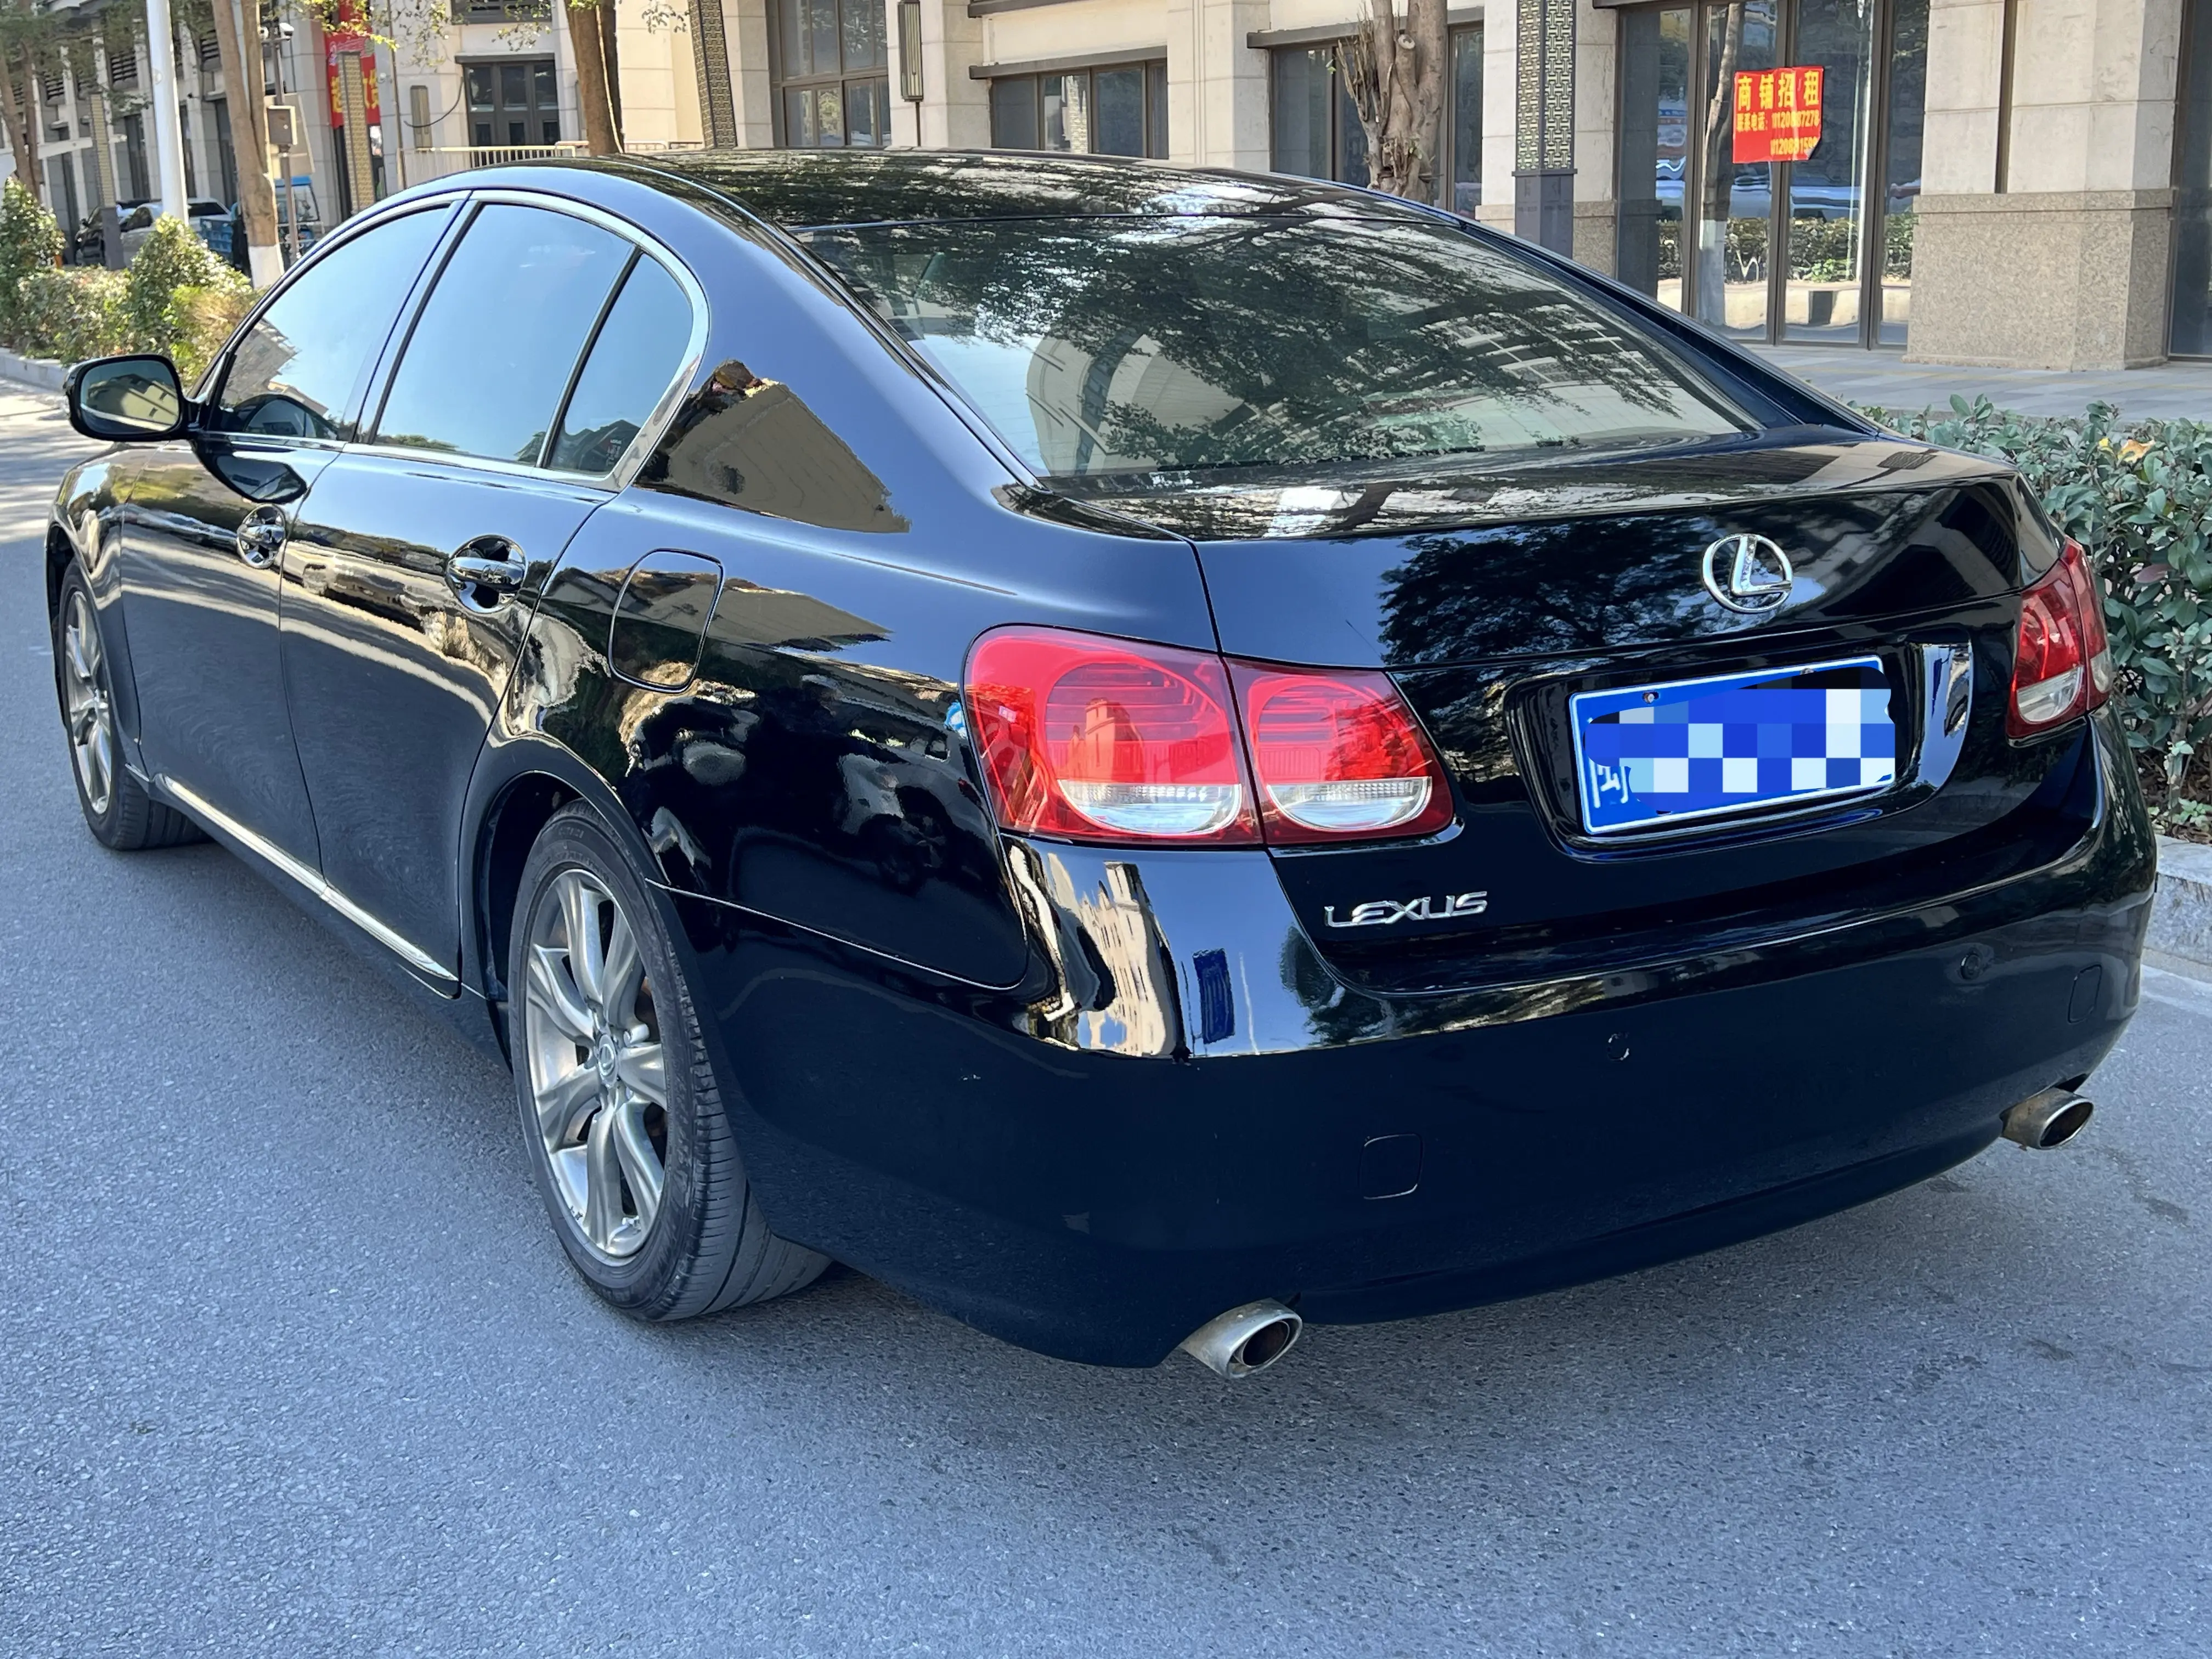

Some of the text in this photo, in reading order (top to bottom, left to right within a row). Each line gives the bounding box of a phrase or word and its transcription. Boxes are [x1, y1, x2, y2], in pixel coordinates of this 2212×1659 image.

[1737, 71, 1819, 111] 商铺招租
[1324, 891, 1488, 928] LEXUS
